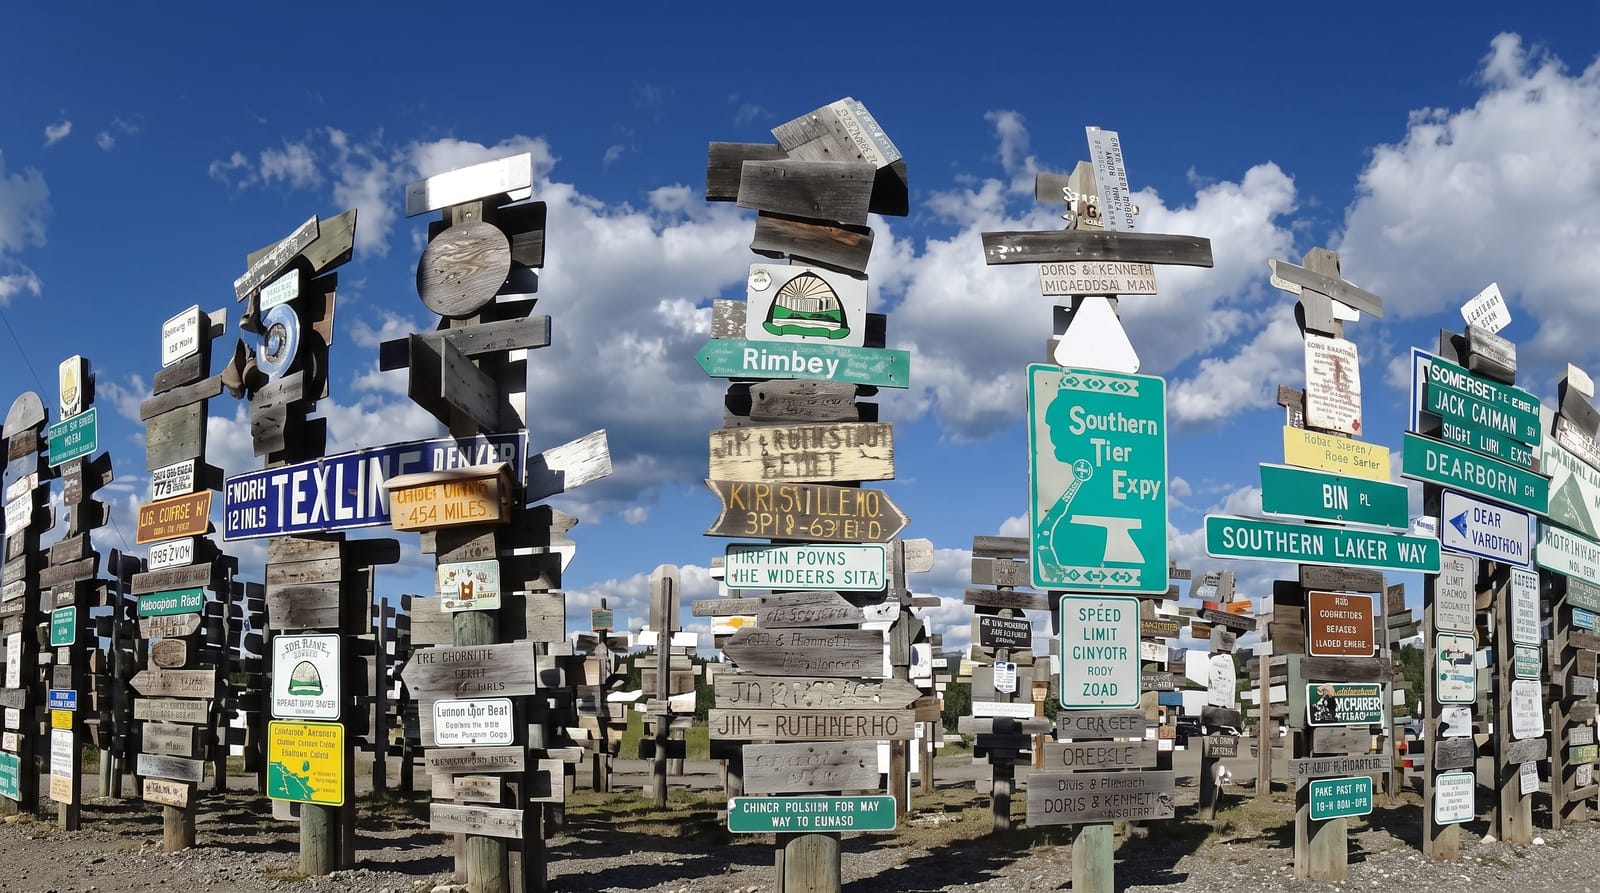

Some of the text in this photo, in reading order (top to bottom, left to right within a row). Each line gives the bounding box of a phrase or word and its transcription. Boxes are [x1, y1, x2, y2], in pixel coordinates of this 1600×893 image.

[1041, 263, 1154, 277] DORIS & KENNETH
[1127, 278, 1155, 291] MAN
[743, 348, 840, 380] Rimbey
[1431, 364, 1497, 402] SOMERSET
[1068, 405, 1158, 436] Southern
[1435, 390, 1465, 418] JACK
[1472, 403, 1517, 436] CAIMAN
[1090, 437, 1132, 468] Tier
[1426, 449, 1517, 497] DEARBORN
[1112, 469, 1162, 501] Expy
[1322, 483, 1372, 510] BIN PL
[409, 500, 487, 525] 454 MILES
[1474, 506, 1502, 529] DEAR
[1222, 526, 1428, 564] SOUTHERN LAKER WAY
[797, 551, 846, 566] POVNS
[767, 569, 836, 585] WIDEERS
[844, 570, 877, 586] SITA
[181, 591, 201, 608] Road
[1078, 607, 1121, 622] SPEED
[1083, 627, 1118, 641] LIMIT
[1082, 683, 1118, 697] ZOAD
[487, 704, 508, 717] Beat
[718, 715, 752, 737] JIM
[835, 802, 854, 812] FOR
[860, 801, 880, 812] MAY
[1044, 797, 1087, 814] DORIS
[1092, 795, 1100, 809] &
[771, 816, 791, 827] WAY
[797, 816, 809, 827] TO
